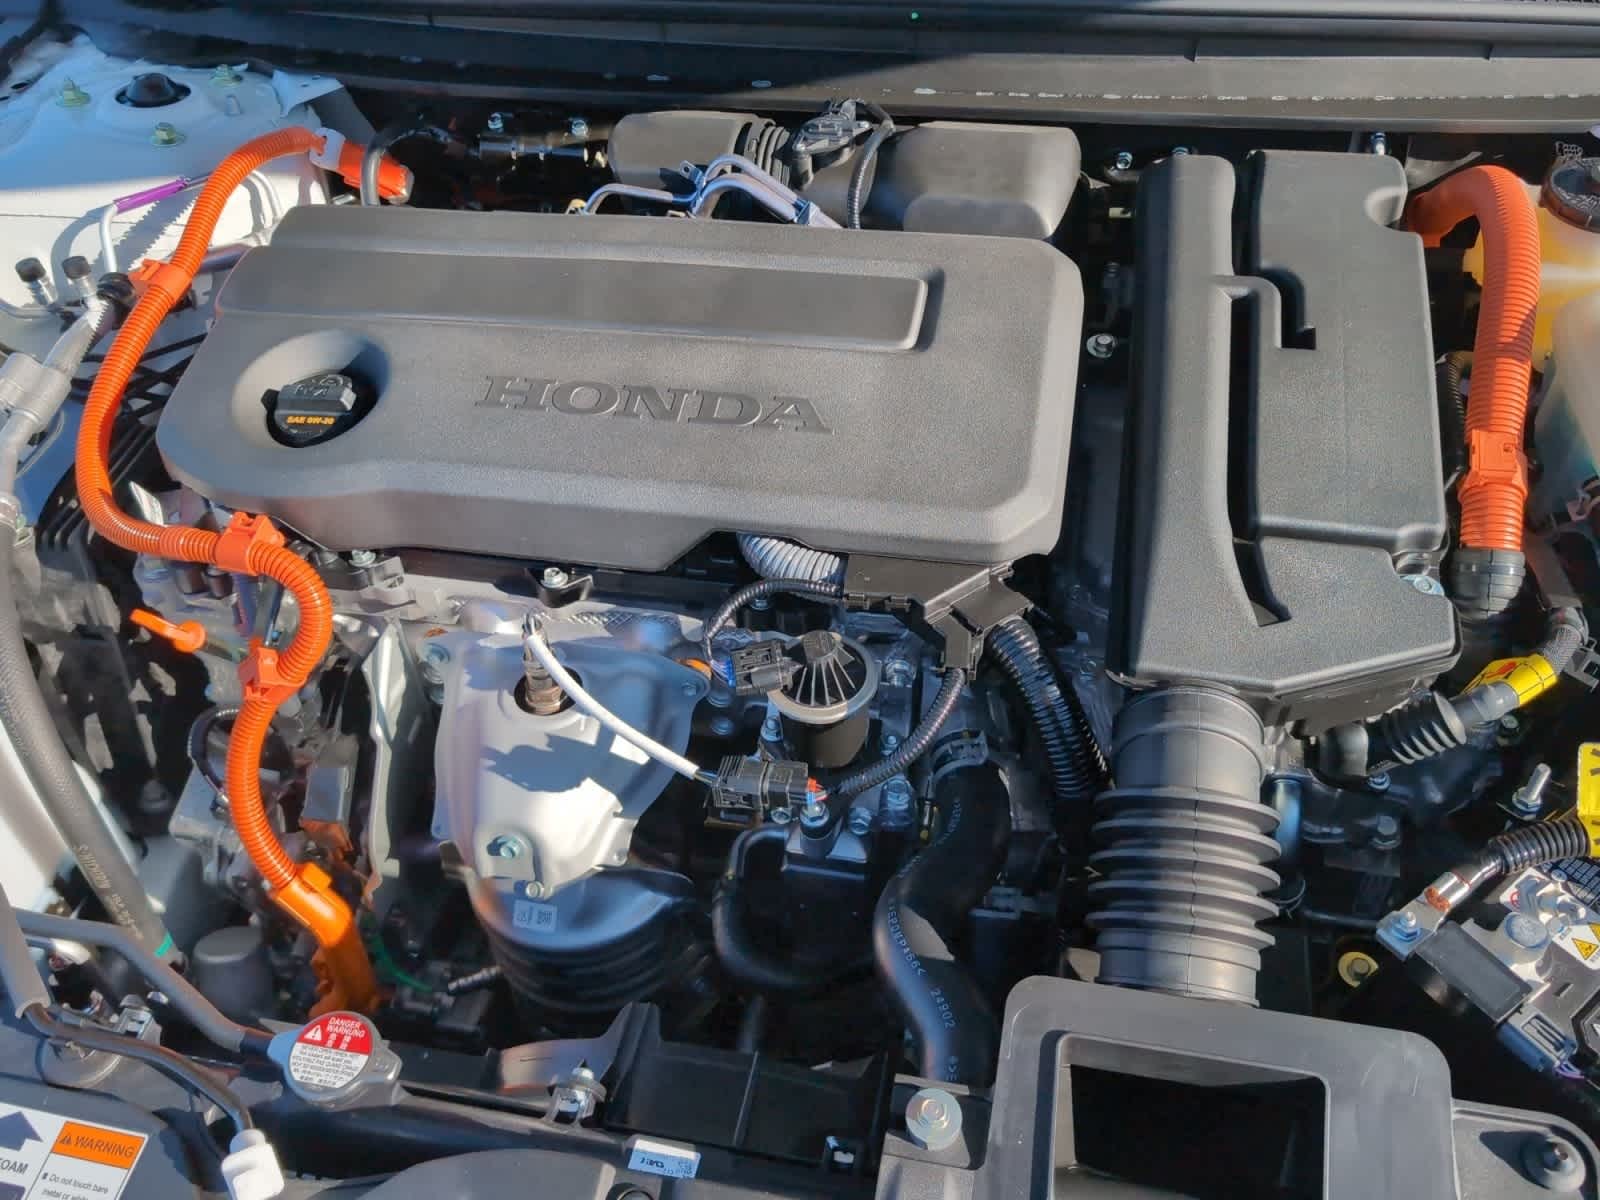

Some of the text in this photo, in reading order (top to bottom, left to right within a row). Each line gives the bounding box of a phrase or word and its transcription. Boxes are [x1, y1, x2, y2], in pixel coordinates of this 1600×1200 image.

[474, 375, 834, 436] HONDA
[328, 1016, 362, 1029] DANGER
[75, 1135, 136, 1158] WARNING
[0, 1158, 28, 1175] OAM
[49, 1173, 60, 1183] Do
[61, 1177, 73, 1186] not
[73, 1179, 92, 1190] touch
